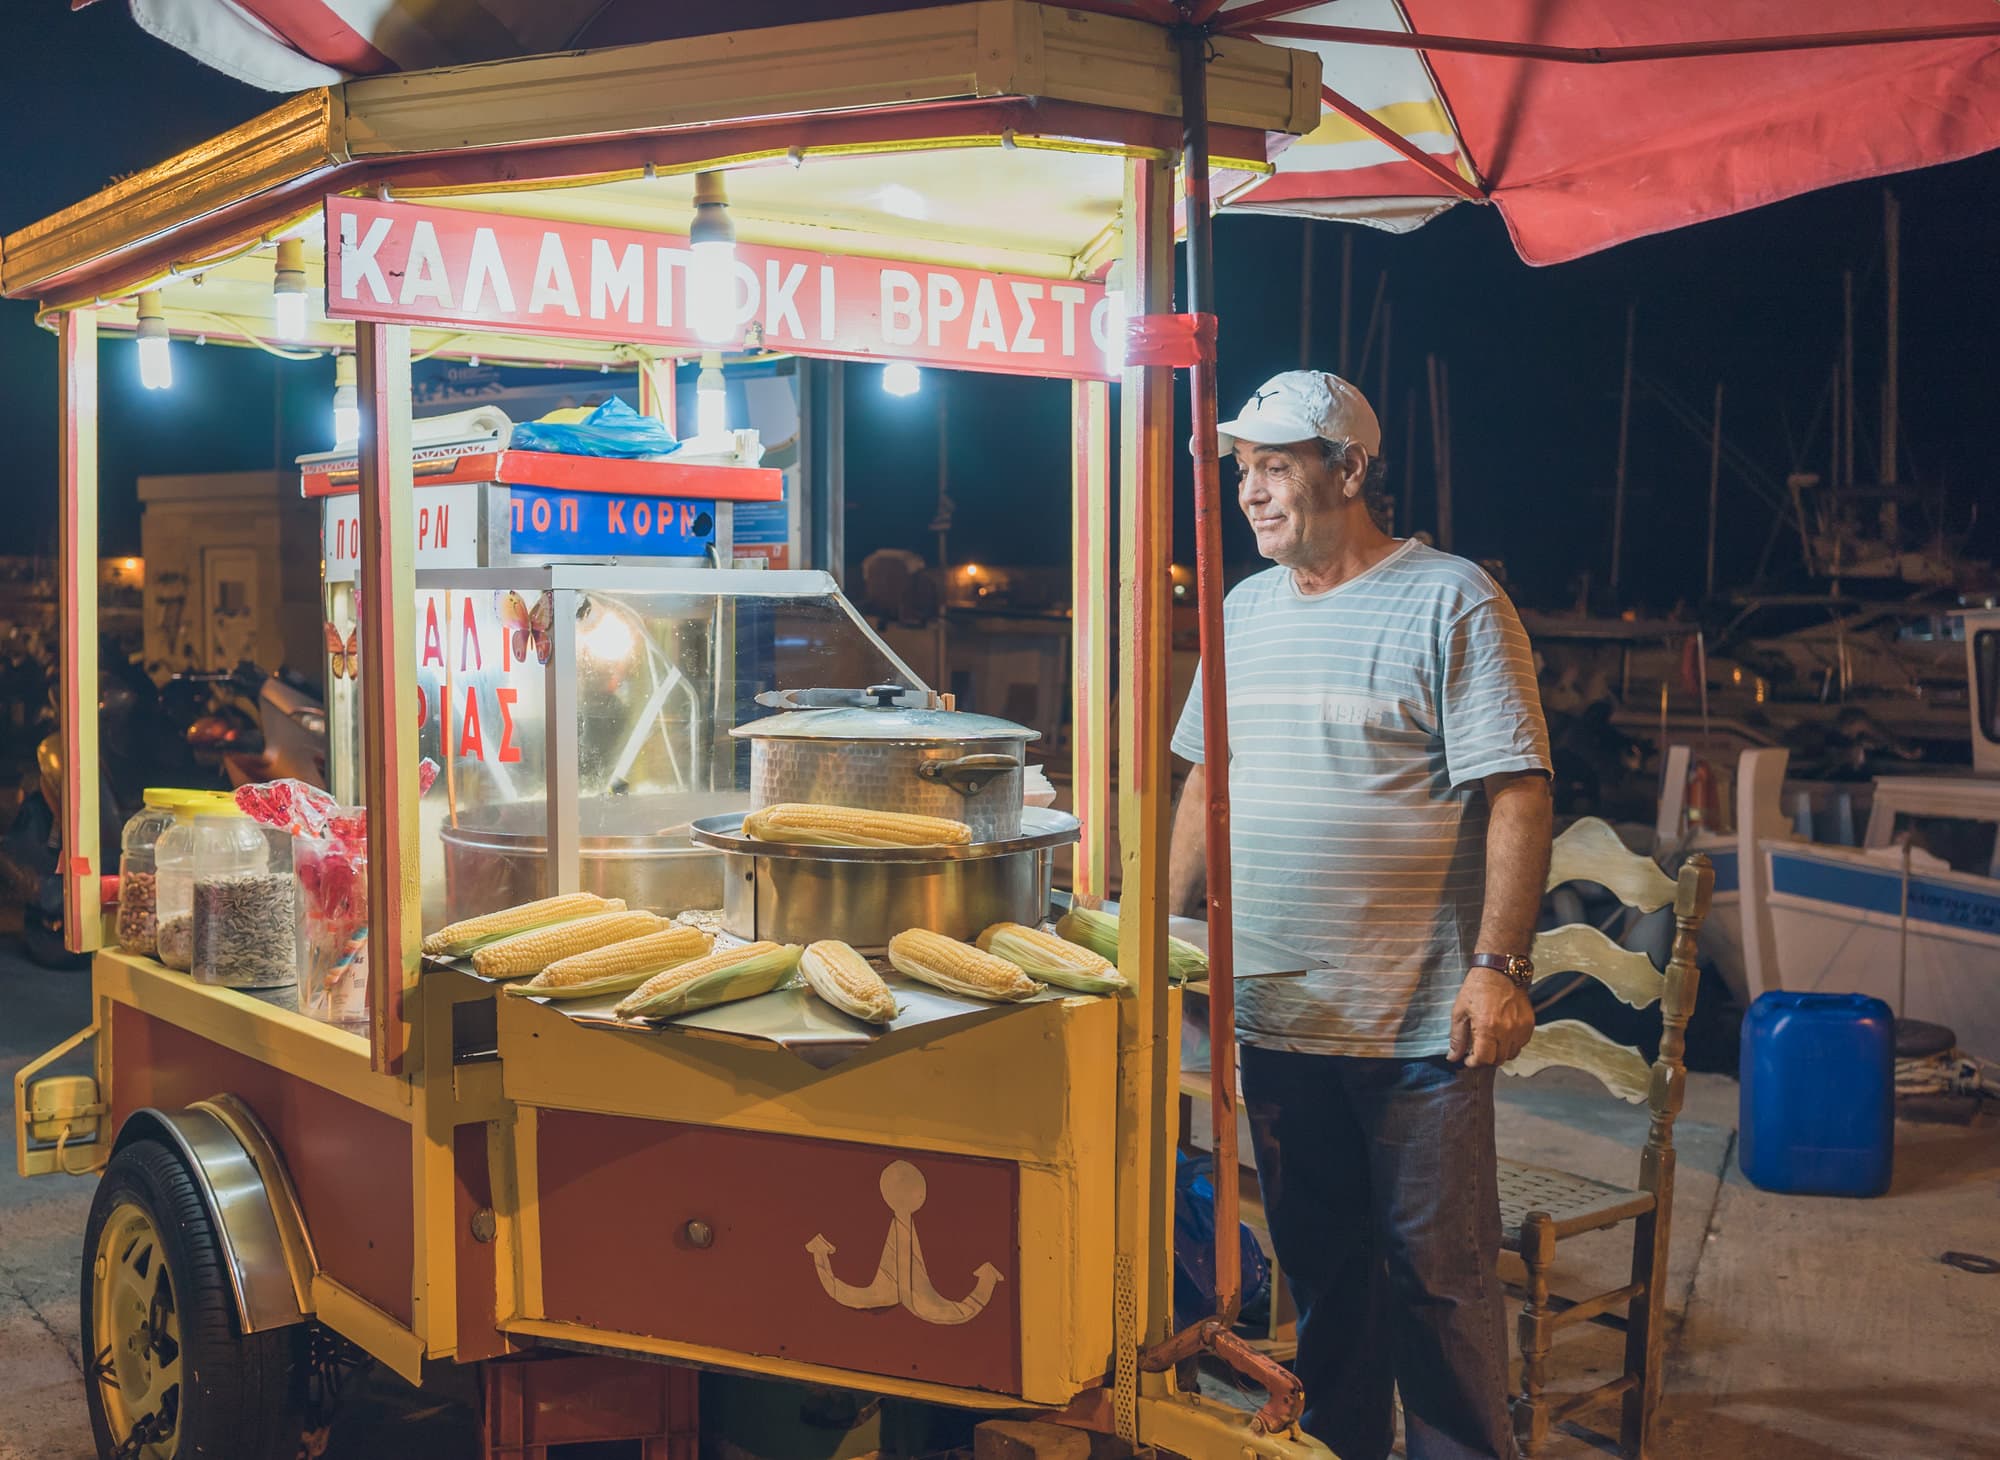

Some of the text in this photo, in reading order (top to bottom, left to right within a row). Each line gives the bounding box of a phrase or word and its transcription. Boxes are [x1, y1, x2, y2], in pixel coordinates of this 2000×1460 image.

[337, 504, 449, 561] ΠΟ ΡΝ
[510, 498, 578, 533] ΠΟΠ
